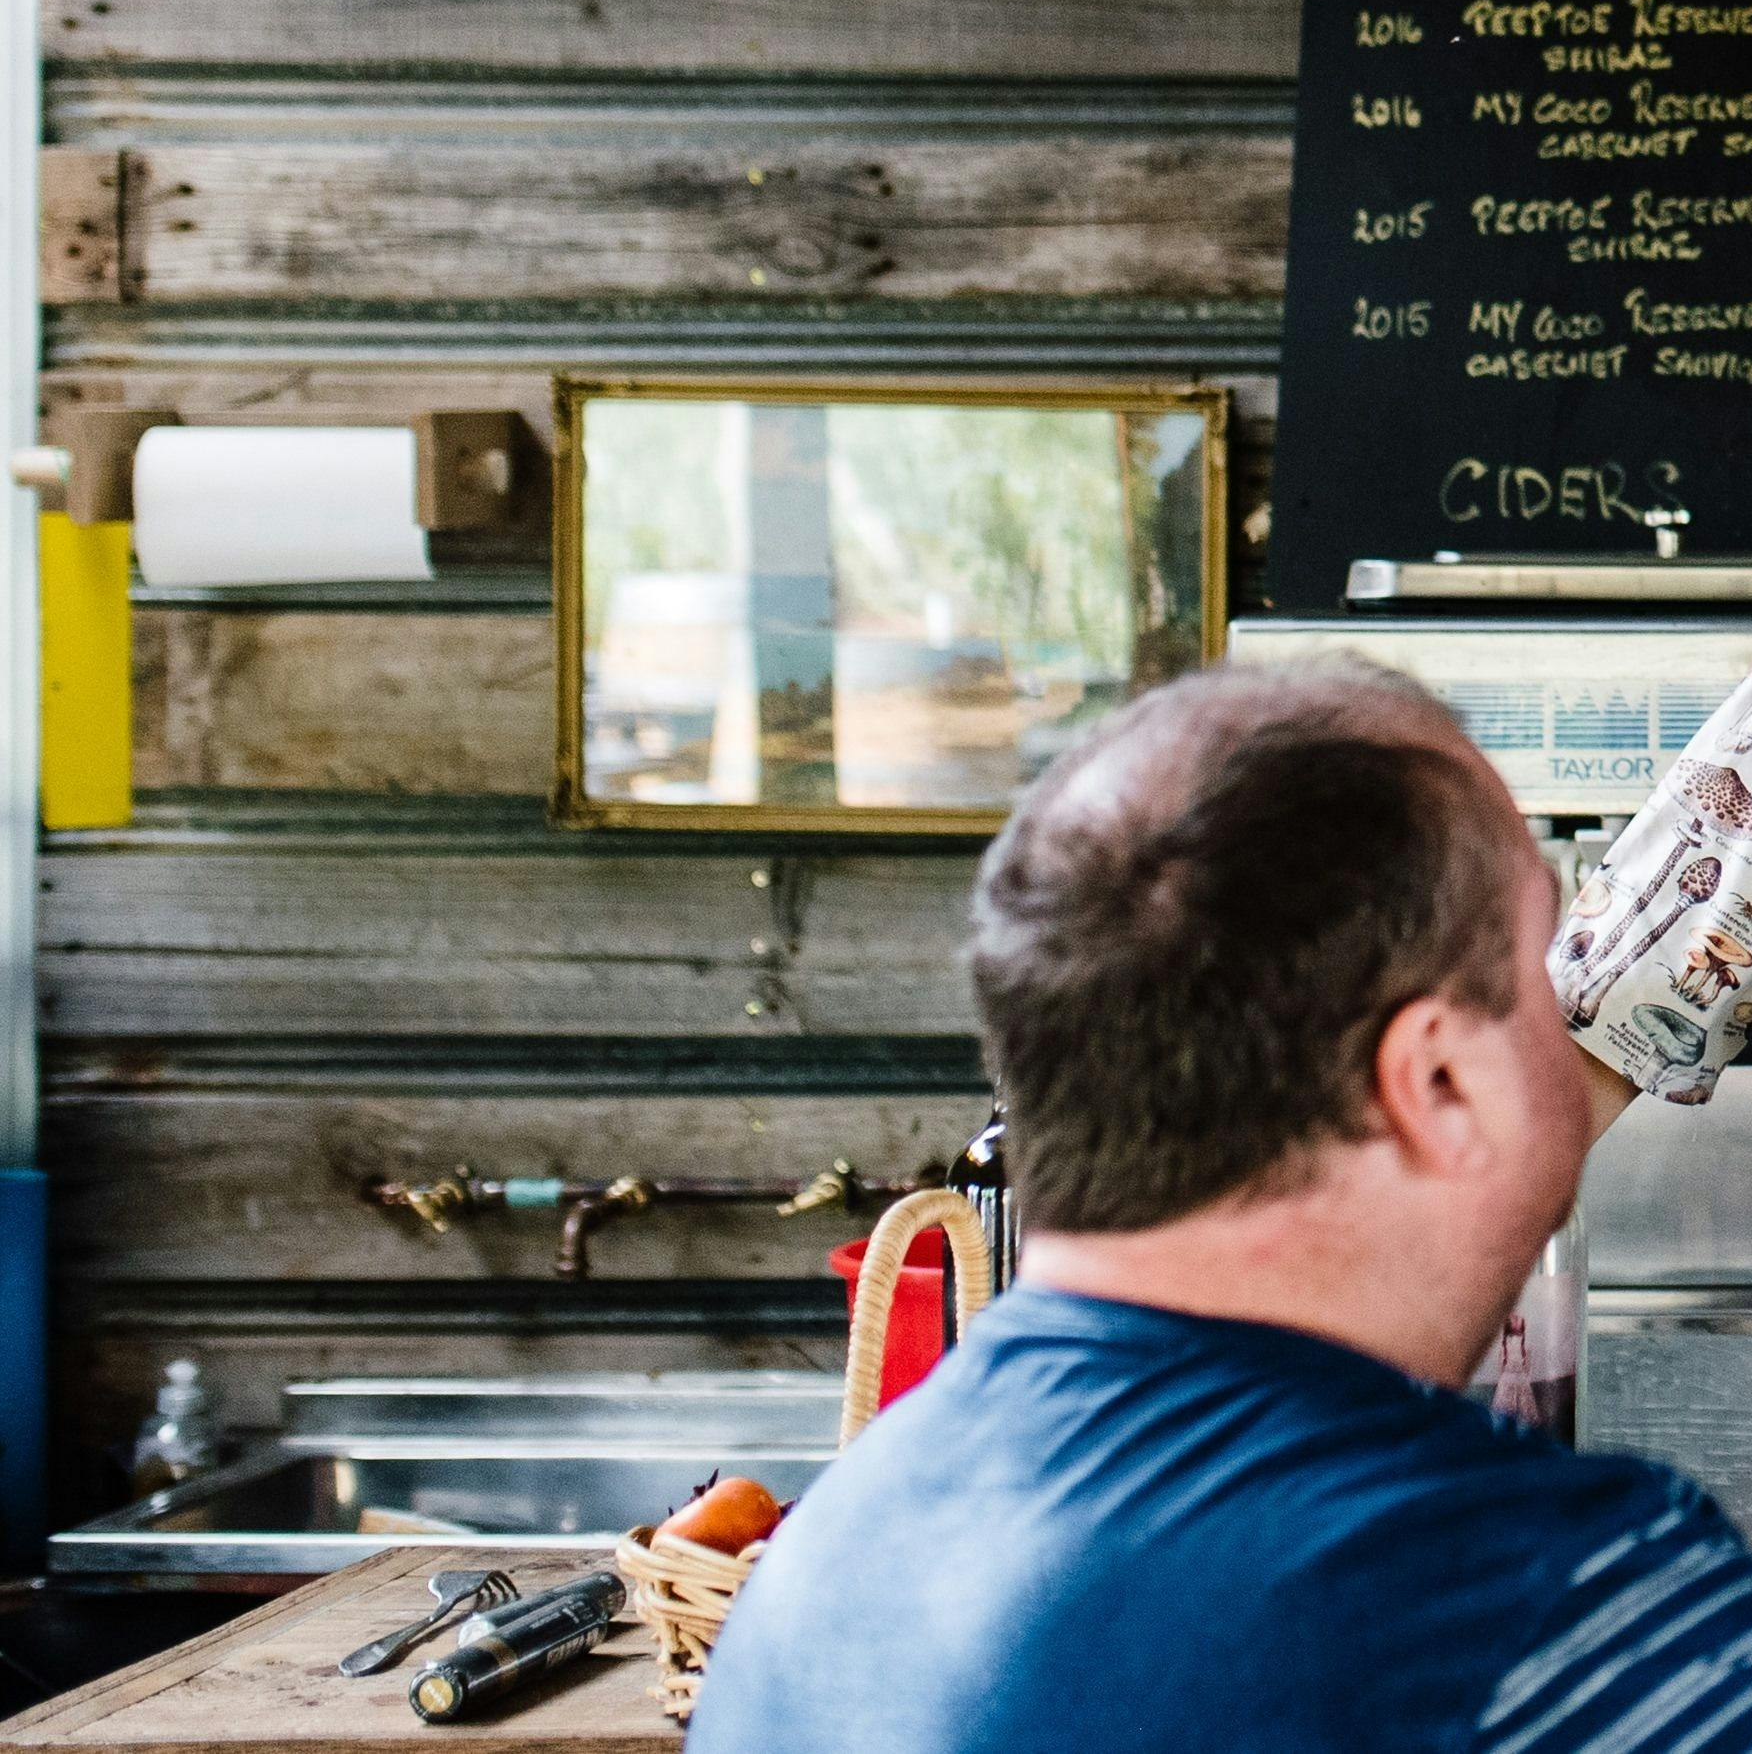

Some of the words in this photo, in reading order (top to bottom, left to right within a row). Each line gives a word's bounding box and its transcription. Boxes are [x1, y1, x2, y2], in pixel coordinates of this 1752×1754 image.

[1356, 11, 1423, 47] 2016
[1543, 43, 1672, 72] SHIRAZ
[1352, 94, 1422, 129] 2016
[1473, 91, 1523, 126] MY
[1354, 199, 1434, 244] 2015
[1352, 296, 1433, 339] 2015
[1469, 301, 1524, 342] MY
[1548, 757, 1655, 781] TAYLOR
